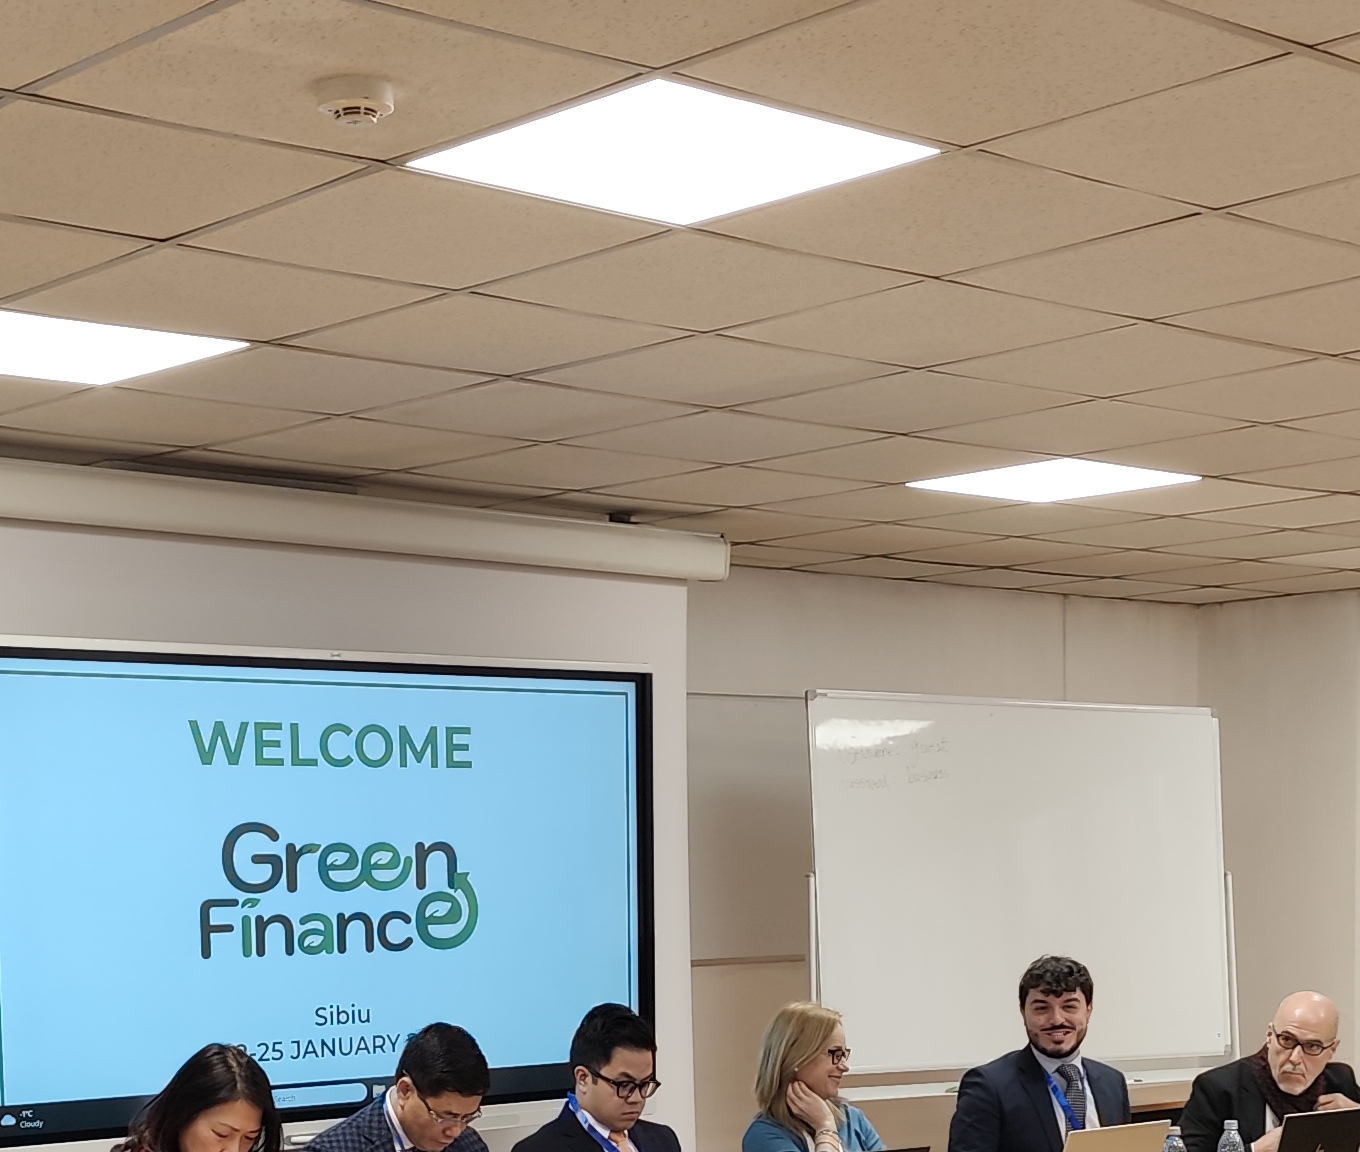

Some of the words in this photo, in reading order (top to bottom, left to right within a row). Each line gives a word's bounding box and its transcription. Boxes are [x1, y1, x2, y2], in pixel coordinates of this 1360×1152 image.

[188, 720, 472, 768] WELCOME
[221, 822, 458, 894] Green
[200, 880, 478, 960] Finance
[315, 1004, 371, 1026] Sibiu
[239, 1041, 284, 1062] -25
[290, 1033, 400, 1060] JANUARY
[20, 1120, 44, 1128] Cloudy
